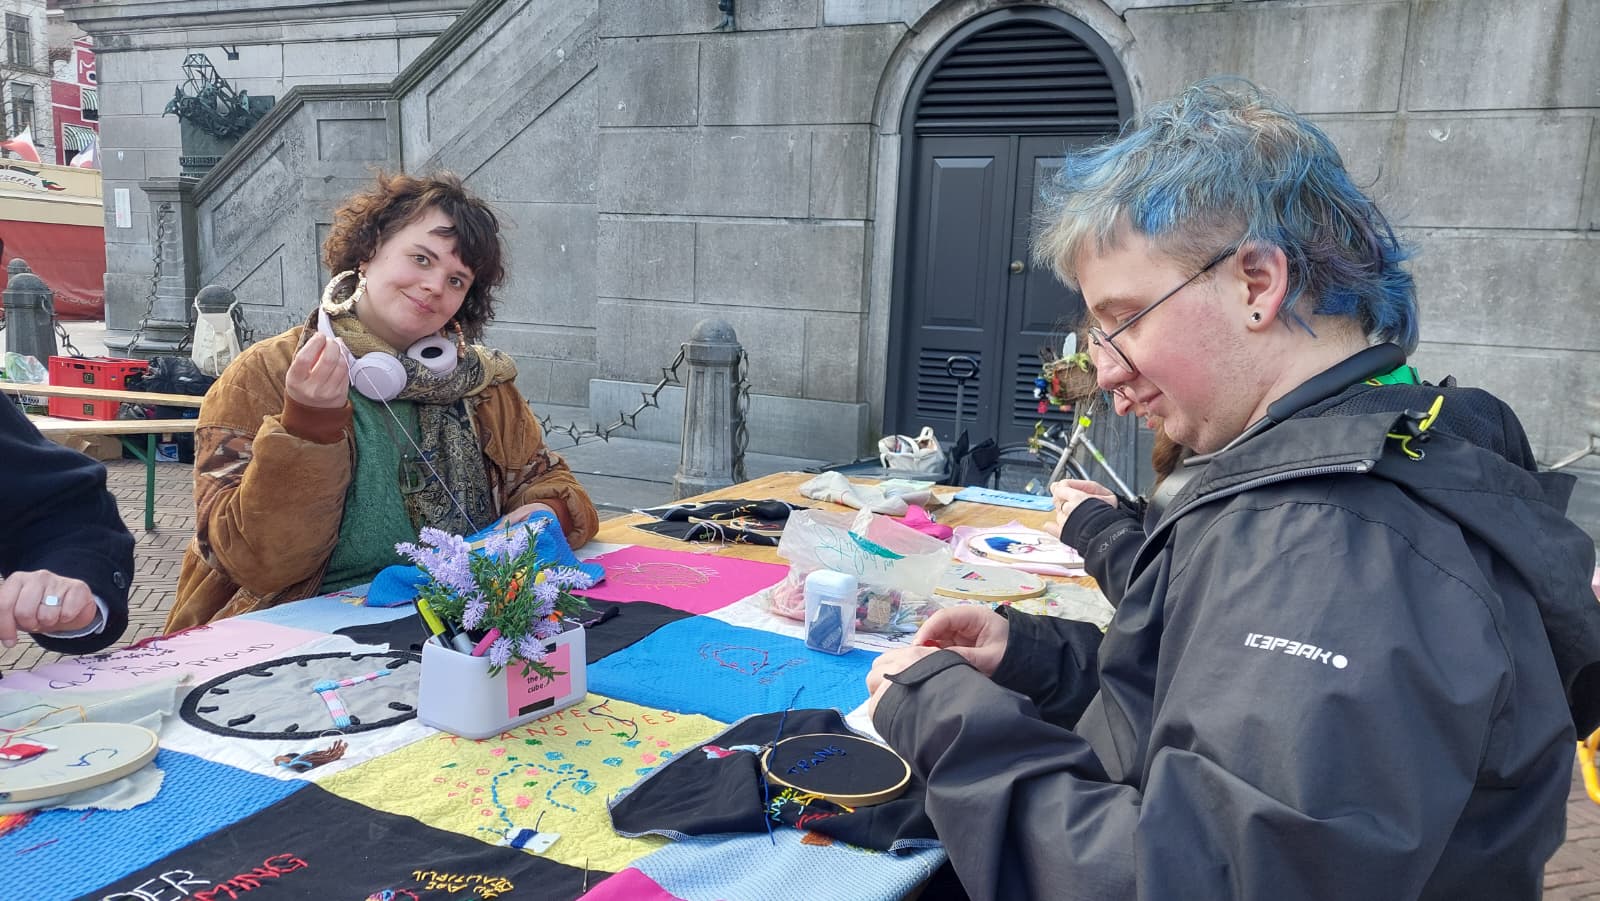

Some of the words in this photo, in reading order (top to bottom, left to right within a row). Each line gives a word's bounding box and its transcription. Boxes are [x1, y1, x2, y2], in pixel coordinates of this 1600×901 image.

[185, 643, 274, 667] PROUD
[1244, 632, 1333, 665] ICEPEAK
[527, 675, 538, 684] the
[584, 710, 676, 733] LIVES
